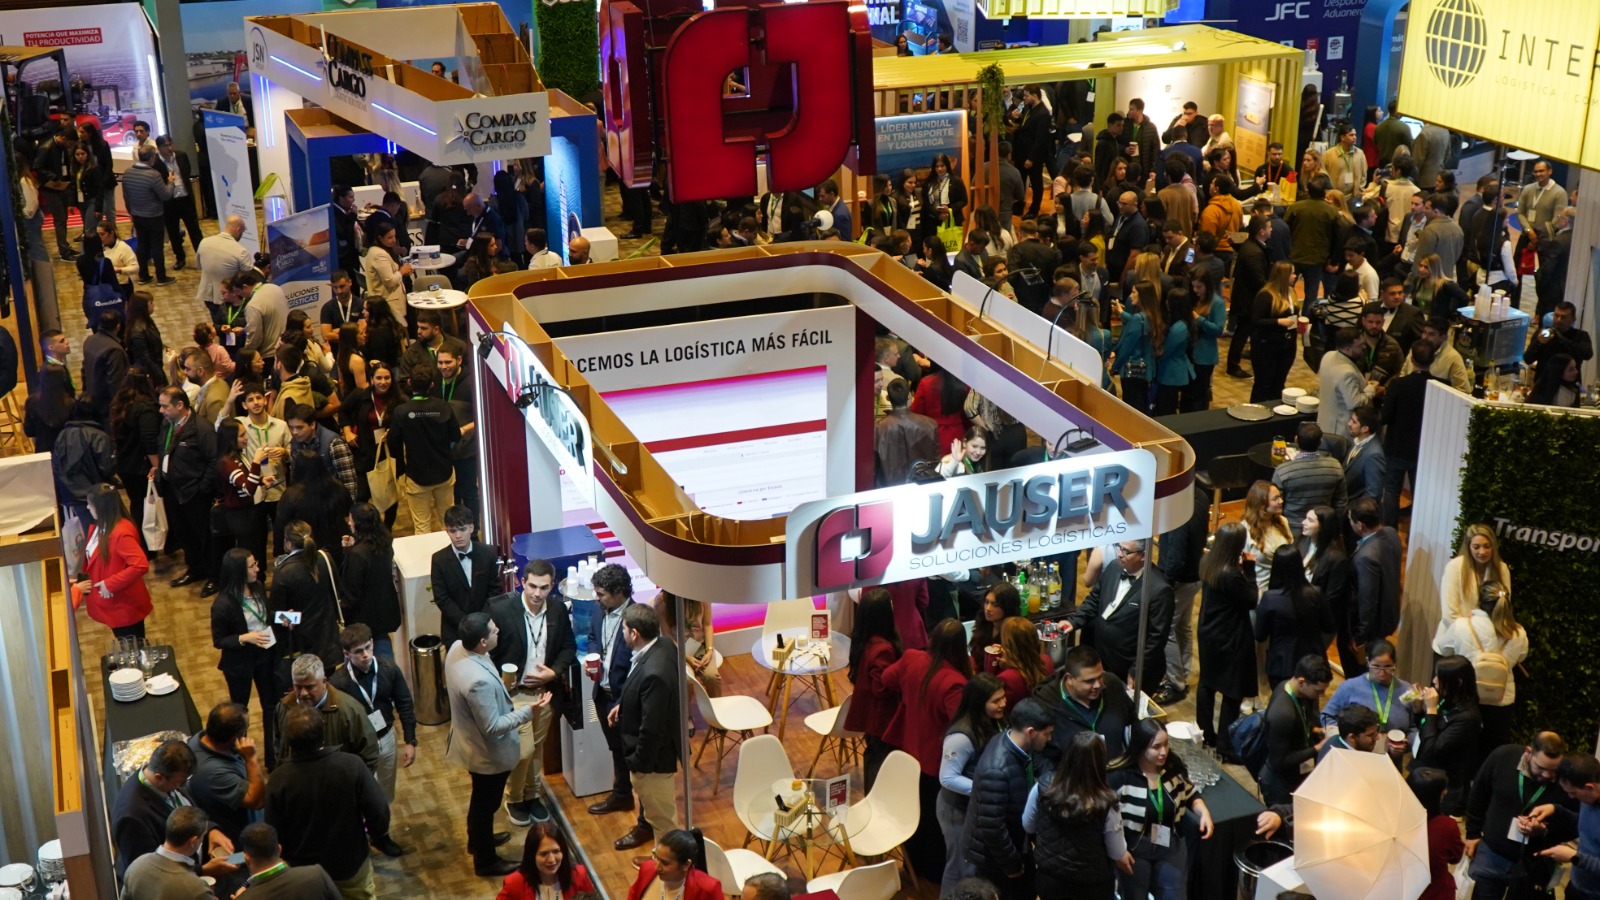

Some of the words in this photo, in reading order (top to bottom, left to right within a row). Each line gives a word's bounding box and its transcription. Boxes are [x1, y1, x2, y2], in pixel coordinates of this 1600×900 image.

[868, 5, 900, 25] NAL
[1264, 1, 1311, 21] JFC
[40, 35, 101, 45] PRODUCTIVIDAD
[252, 42, 265, 63] JSN
[465, 111, 537, 130] COMPASS
[880, 122, 908, 133] LÍDER
[910, 119, 952, 130] MUNDIAL
[470, 129, 526, 146] CARGO
[877, 134, 891, 142] EN
[893, 127, 954, 141] TRANSPORTE
[888, 142, 894, 150] Y
[895, 137, 945, 150] LOGÍSTICA
[945, 240, 958, 248] LFA
[285, 285, 320, 299] LUCIONES
[571, 352, 634, 373] CEMOS
[640, 349, 659, 365] LA
[665, 339, 746, 363] LOGÍSTICA
[752, 332, 786, 352] MÁS
[792, 328, 833, 348] FÁCIL
[911, 463, 1131, 546] JAUSER
[909, 541, 1023, 570] SOLUCIONES
[1028, 521, 1128, 549] LOGÍSTICAS
